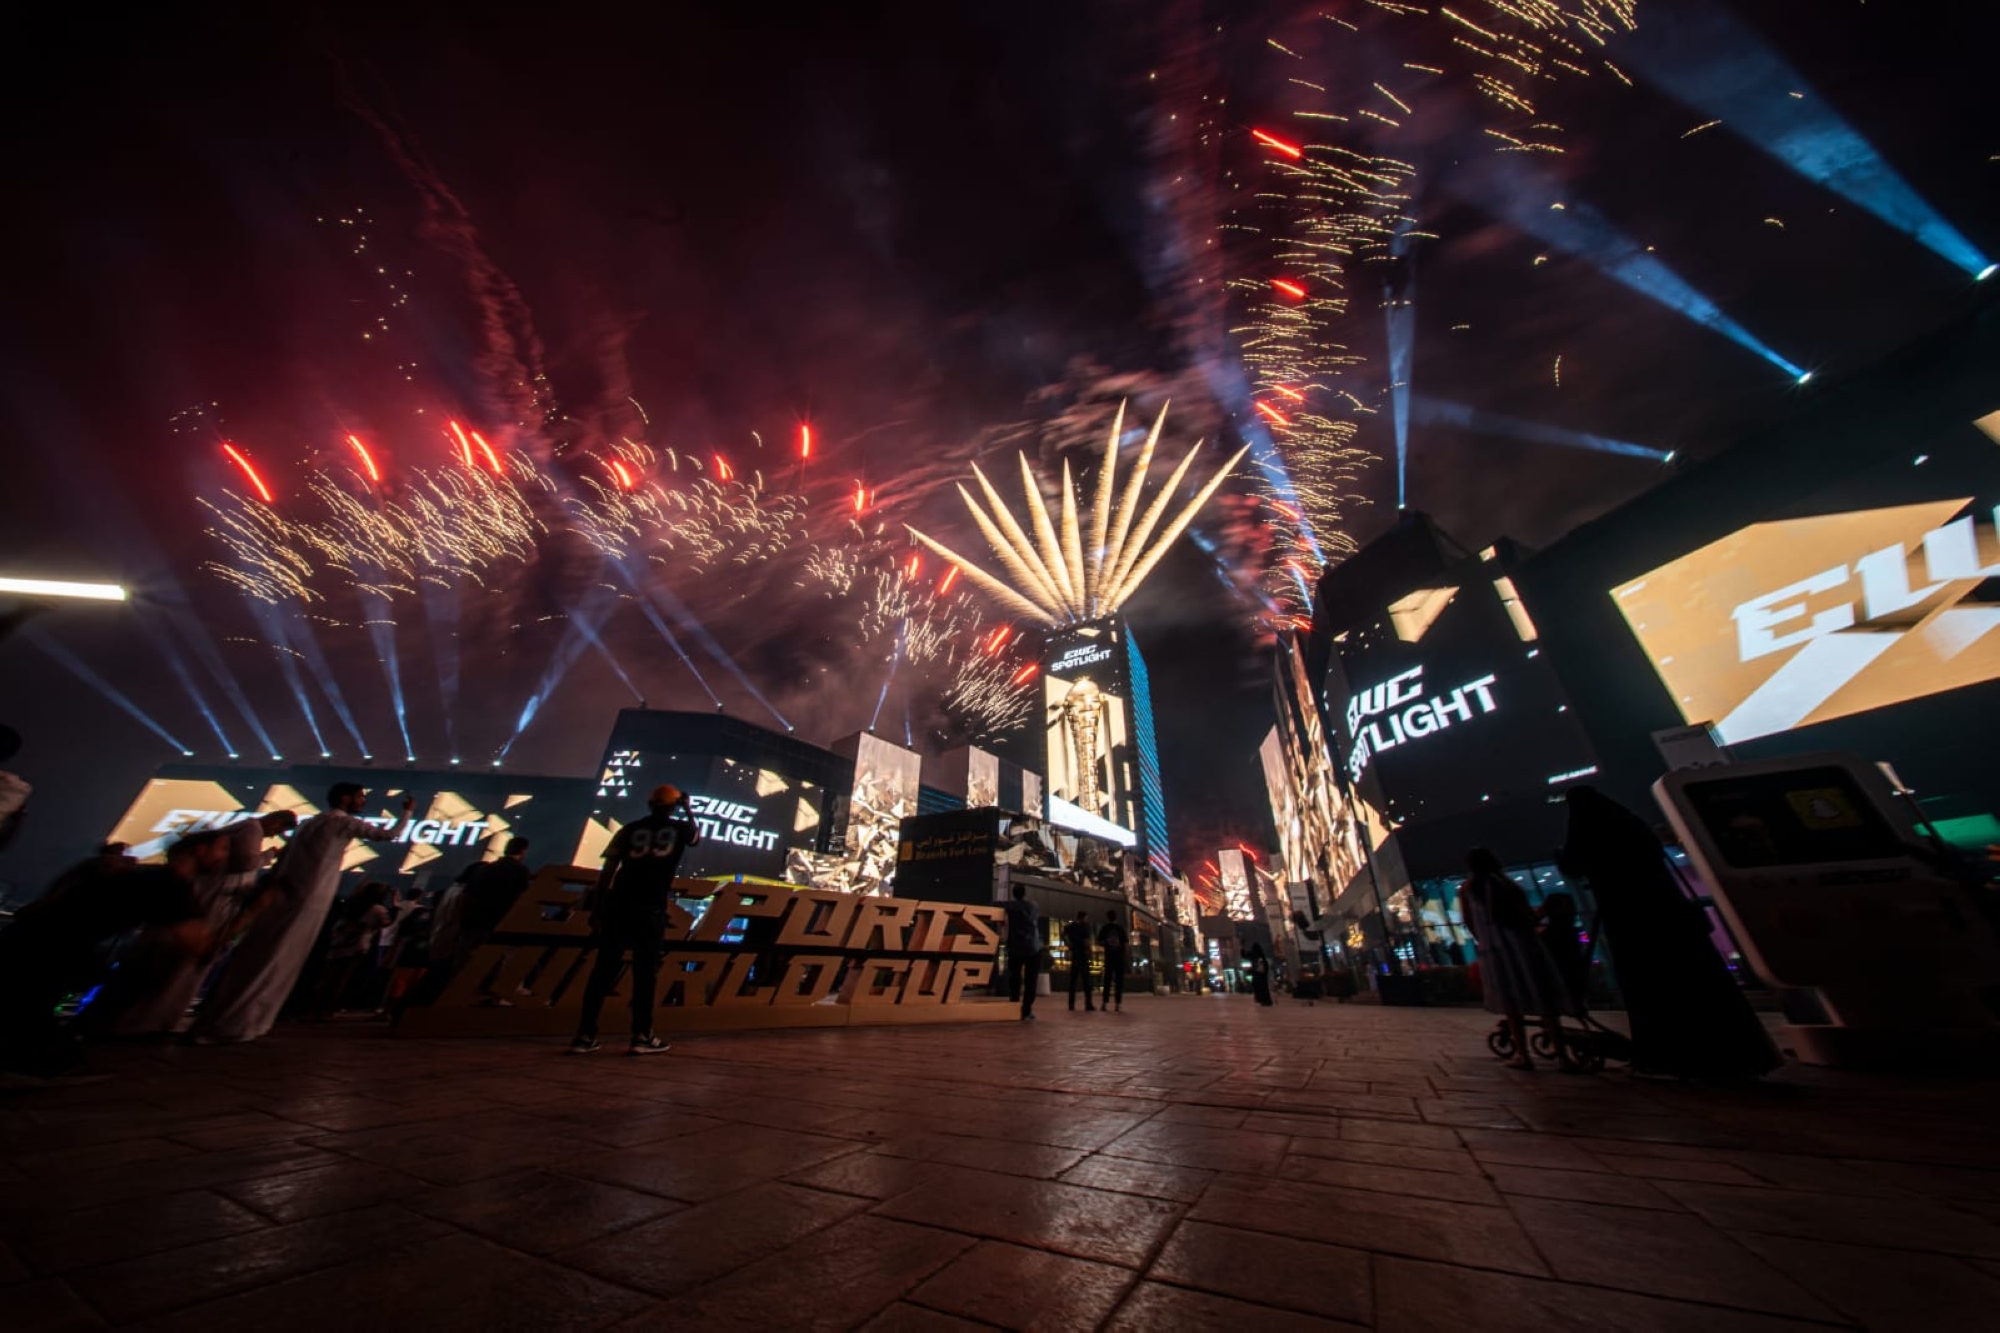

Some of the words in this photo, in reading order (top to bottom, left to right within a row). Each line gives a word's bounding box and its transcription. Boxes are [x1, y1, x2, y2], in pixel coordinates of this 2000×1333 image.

[1051, 649, 1113, 672] SPOTLIGHT
[1064, 645, 1098, 661] EWC
[1346, 665, 1423, 739] EWC
[1349, 673, 1497, 783] SPOTLIGHT
[629, 825, 677, 859] 99
[669, 814, 779, 850] TLIGHT
[851, 958, 994, 1004] CUP
